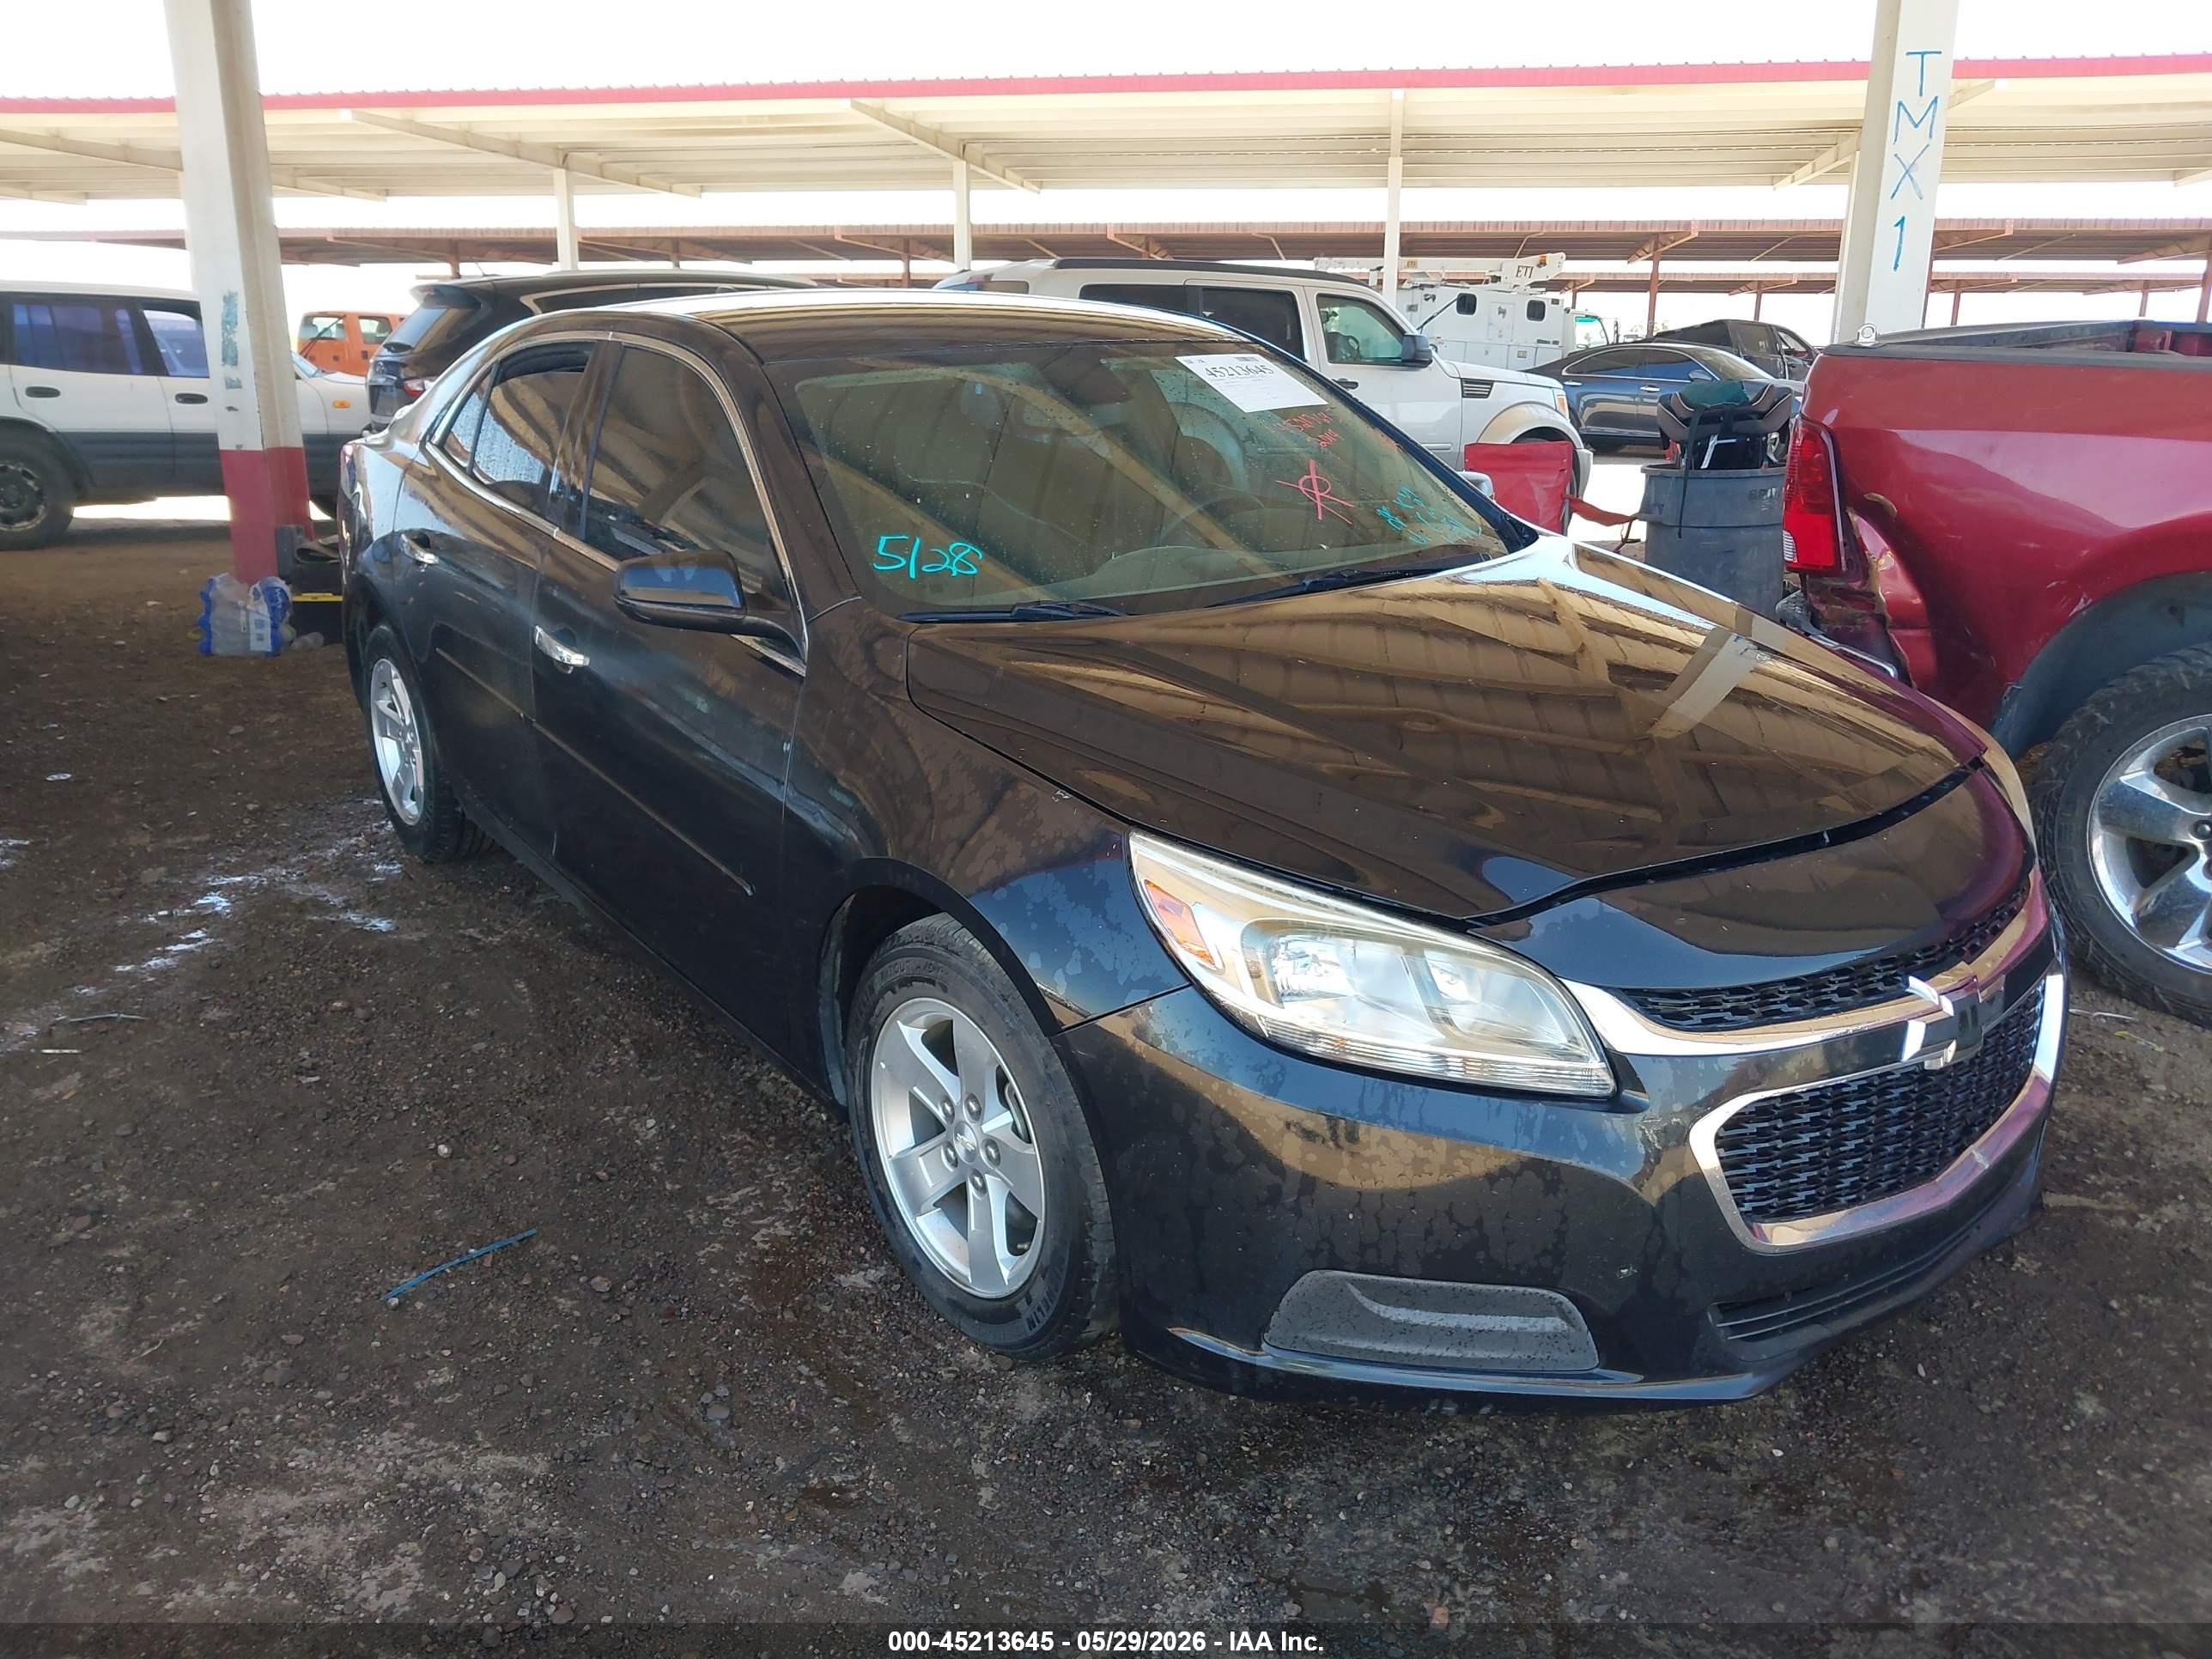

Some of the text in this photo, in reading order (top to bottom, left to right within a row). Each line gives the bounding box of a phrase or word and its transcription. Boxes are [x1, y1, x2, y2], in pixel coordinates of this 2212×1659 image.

[1516, 264, 1534, 279] ETI
[1204, 364, 1275, 378] 45213645
[872, 535, 983, 579] 5/28
